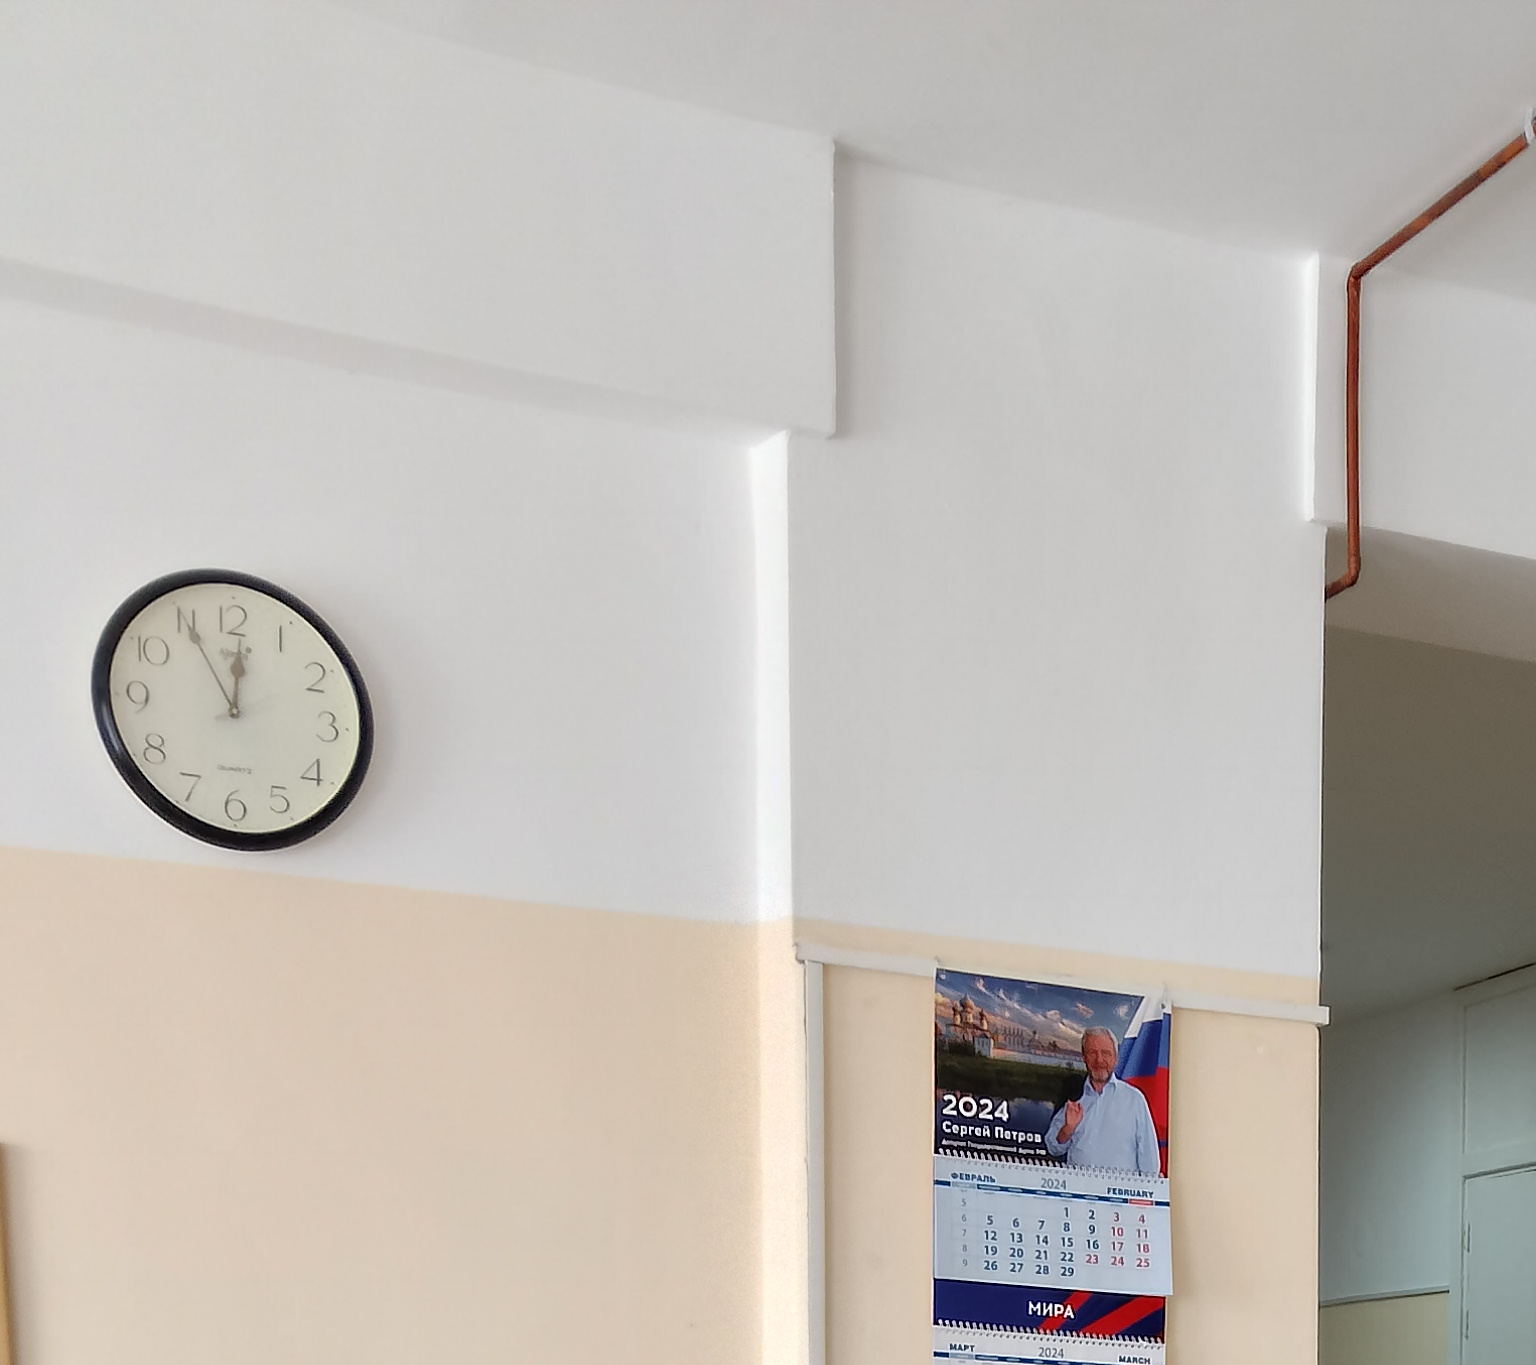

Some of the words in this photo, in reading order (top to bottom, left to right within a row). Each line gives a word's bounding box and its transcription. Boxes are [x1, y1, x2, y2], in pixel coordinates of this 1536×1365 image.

[218, 604, 247, 637] 12
[137, 635, 170, 666] 10
[278, 625, 282, 653] 1
[304, 661, 326, 694] 2
[126, 680, 149, 714] 9
[316, 710, 339, 743] 3
[142, 733, 167, 765] 8
[179, 771, 202, 802] 7
[300, 758, 323, 787] 4
[224, 789, 247, 822] 6
[269, 785, 290, 814] 5
[942, 1094, 1009, 1122] 2024
[942, 1120, 991, 1138] Сергей
[994, 1126, 1042, 1144] Петров
[950, 1172, 996, 1183] ФЕВРАЛЬ
[1040, 1177, 1067, 1190] 2024
[1107, 1187, 1154, 1199] FEBRUARY
[986, 1214, 994, 1225] 5
[1012, 1217, 1020, 1228] 6
[1038, 1220, 1045, 1230] 7
[1063, 1222, 1071, 1232] 8
[1088, 1224, 1096, 1235] 9
[1111, 1227, 1124, 1237] 10
[1136, 1228, 1148, 1239] 11
[1064, 1207, 1069, 1218] 1
[1088, 1209, 1096, 1220] 2
[1113, 1211, 1120, 1222] 3
[1139, 1214, 1145, 1224] 4
[984, 1230, 998, 1241] 12
[1010, 1232, 1023, 1243] 13
[1035, 1234, 1049, 1246] 14
[1061, 1237, 1074, 1248] 15
[1086, 1239, 1100, 1250] 16
[1111, 1241, 1124, 1252] 17
[1136, 1243, 1150, 1253] 18
[983, 1260, 998, 1271] 26
[1009, 1262, 1024, 1273] 27
[1035, 1265, 1050, 1275] 28
[1060, 1266, 1074, 1277] 29
[984, 1245, 998, 1256] 19
[1009, 1247, 1024, 1258] 20
[1035, 1249, 1048, 1261] 21
[1060, 1251, 1074, 1262] 22
[1085, 1254, 1099, 1264] 23
[1111, 1256, 1125, 1266] 24
[1136, 1258, 1150, 1268] 25
[1028, 1300, 1075, 1319] МИРА
[949, 1343, 975, 1352] МАРТ
[1038, 1346, 1064, 1359] 2024
[1119, 1355, 1151, 1365] MARCH
